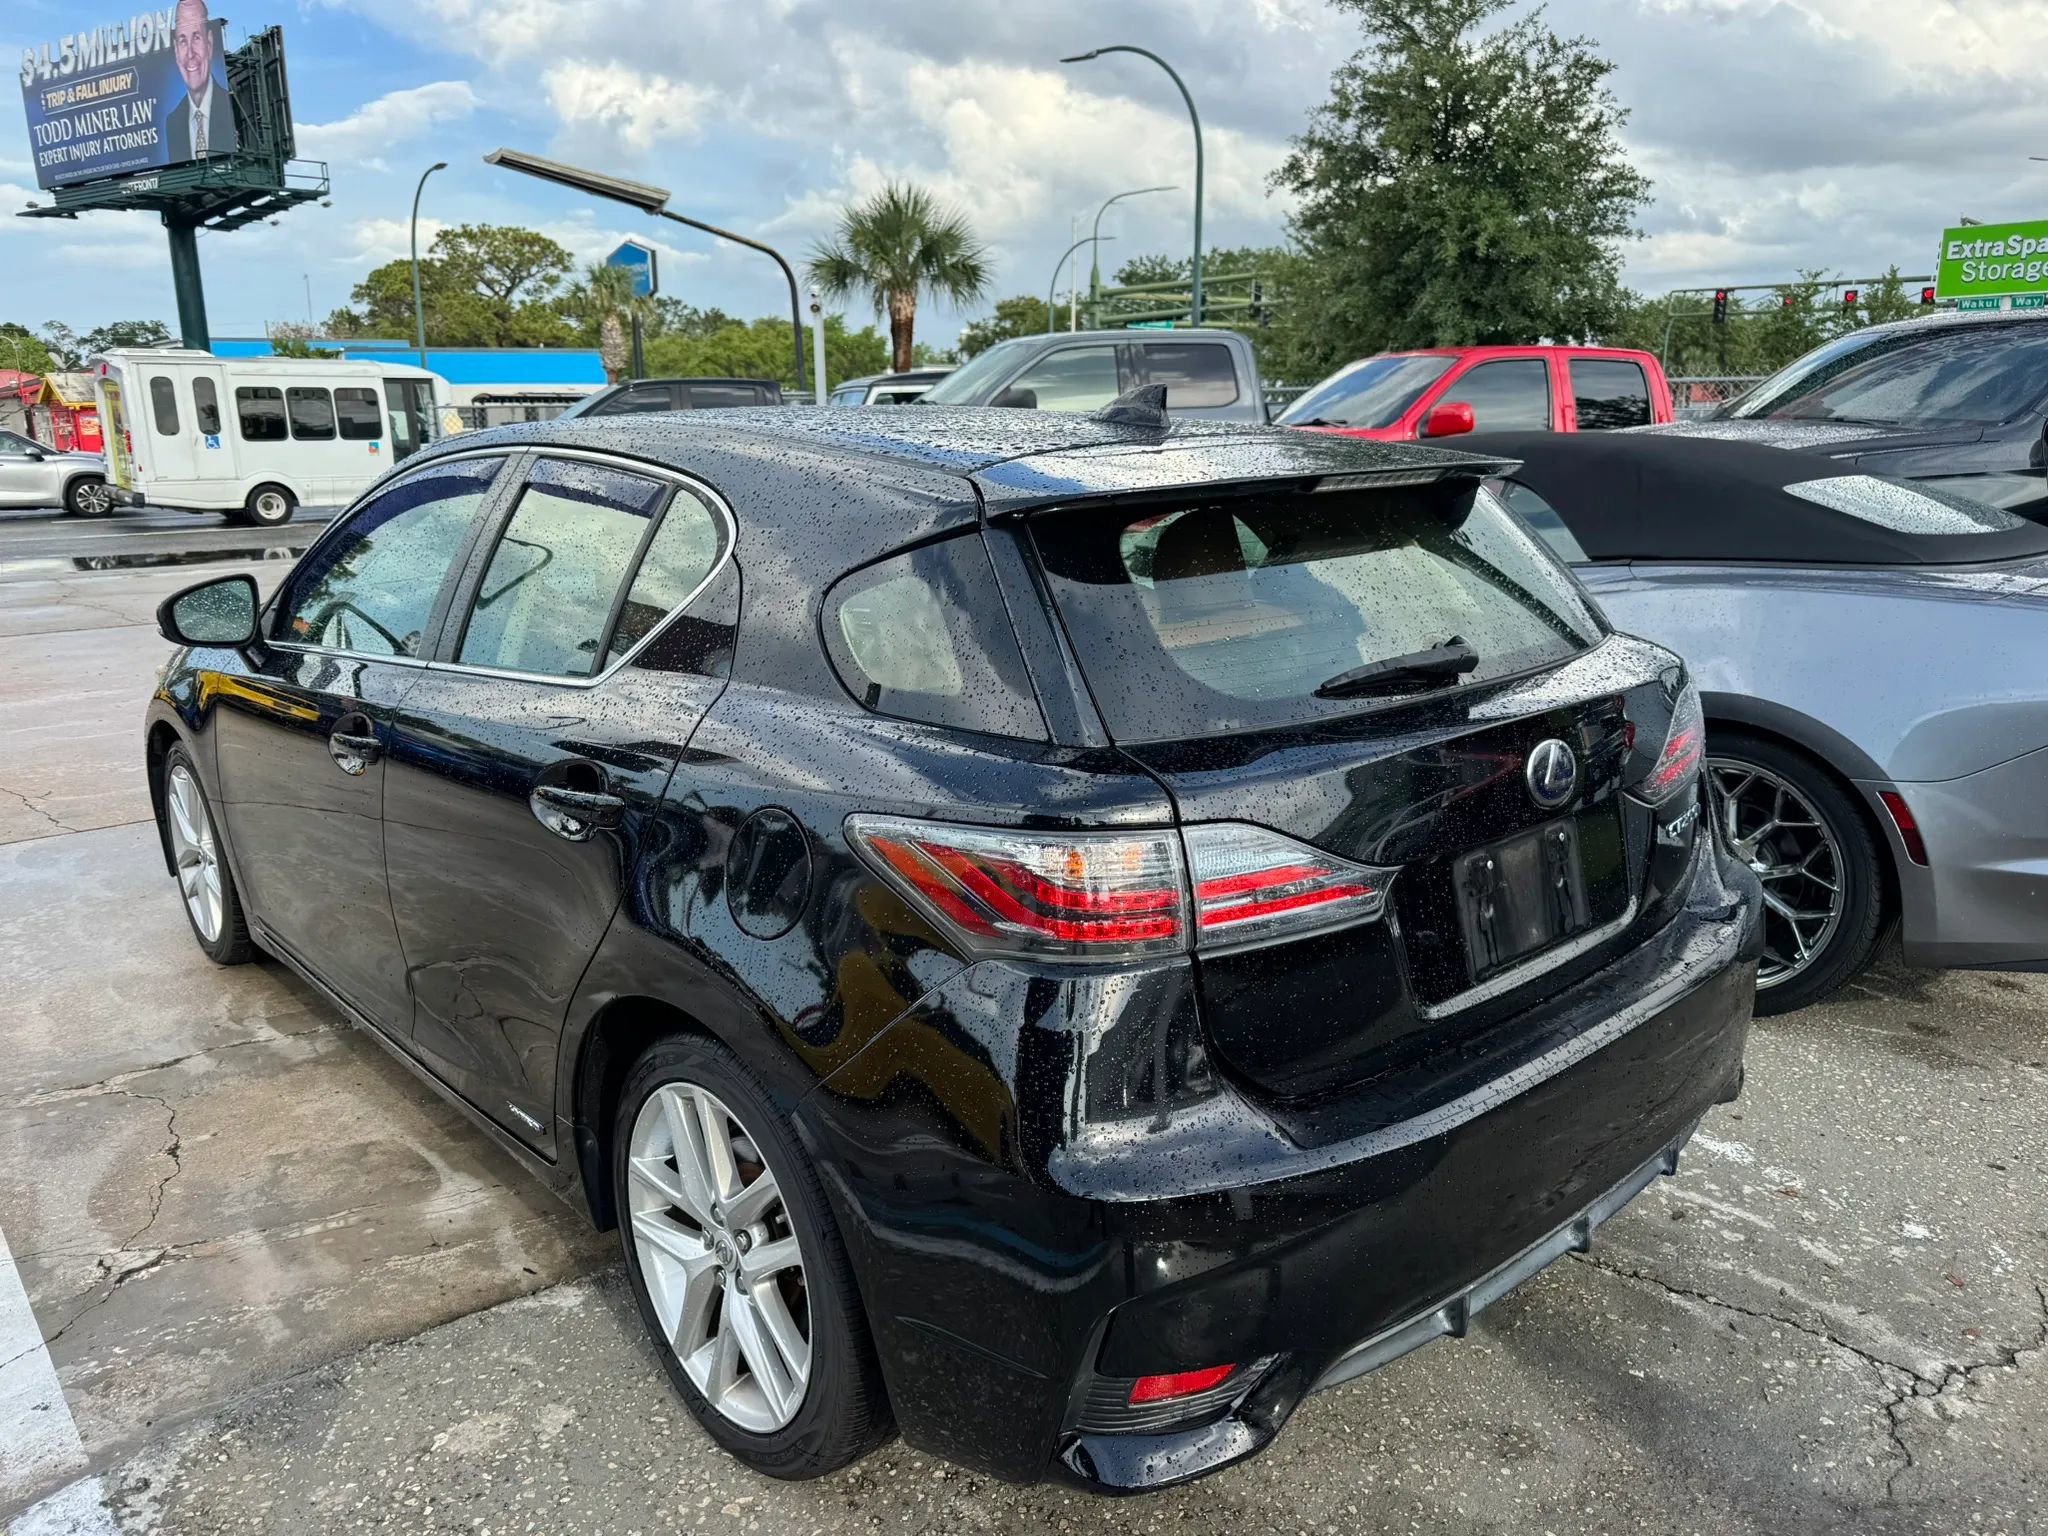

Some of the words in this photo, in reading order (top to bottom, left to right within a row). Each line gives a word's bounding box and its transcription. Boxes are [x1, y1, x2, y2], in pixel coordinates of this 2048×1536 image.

[46, 89, 67, 109] TRIP
[67, 87, 77, 104] &
[76, 82, 99, 102] FALL
[99, 72, 133, 96] INJURY
[34, 118, 73, 147] TODD
[74, 107, 122, 138] MINER
[39, 146, 69, 167] EXPERT
[69, 139, 102, 162] INJURY
[104, 128, 159, 155] ATTORNEYS
[1961, 260, 2048, 282] Storage
[2015, 297, 2041, 307] Way
